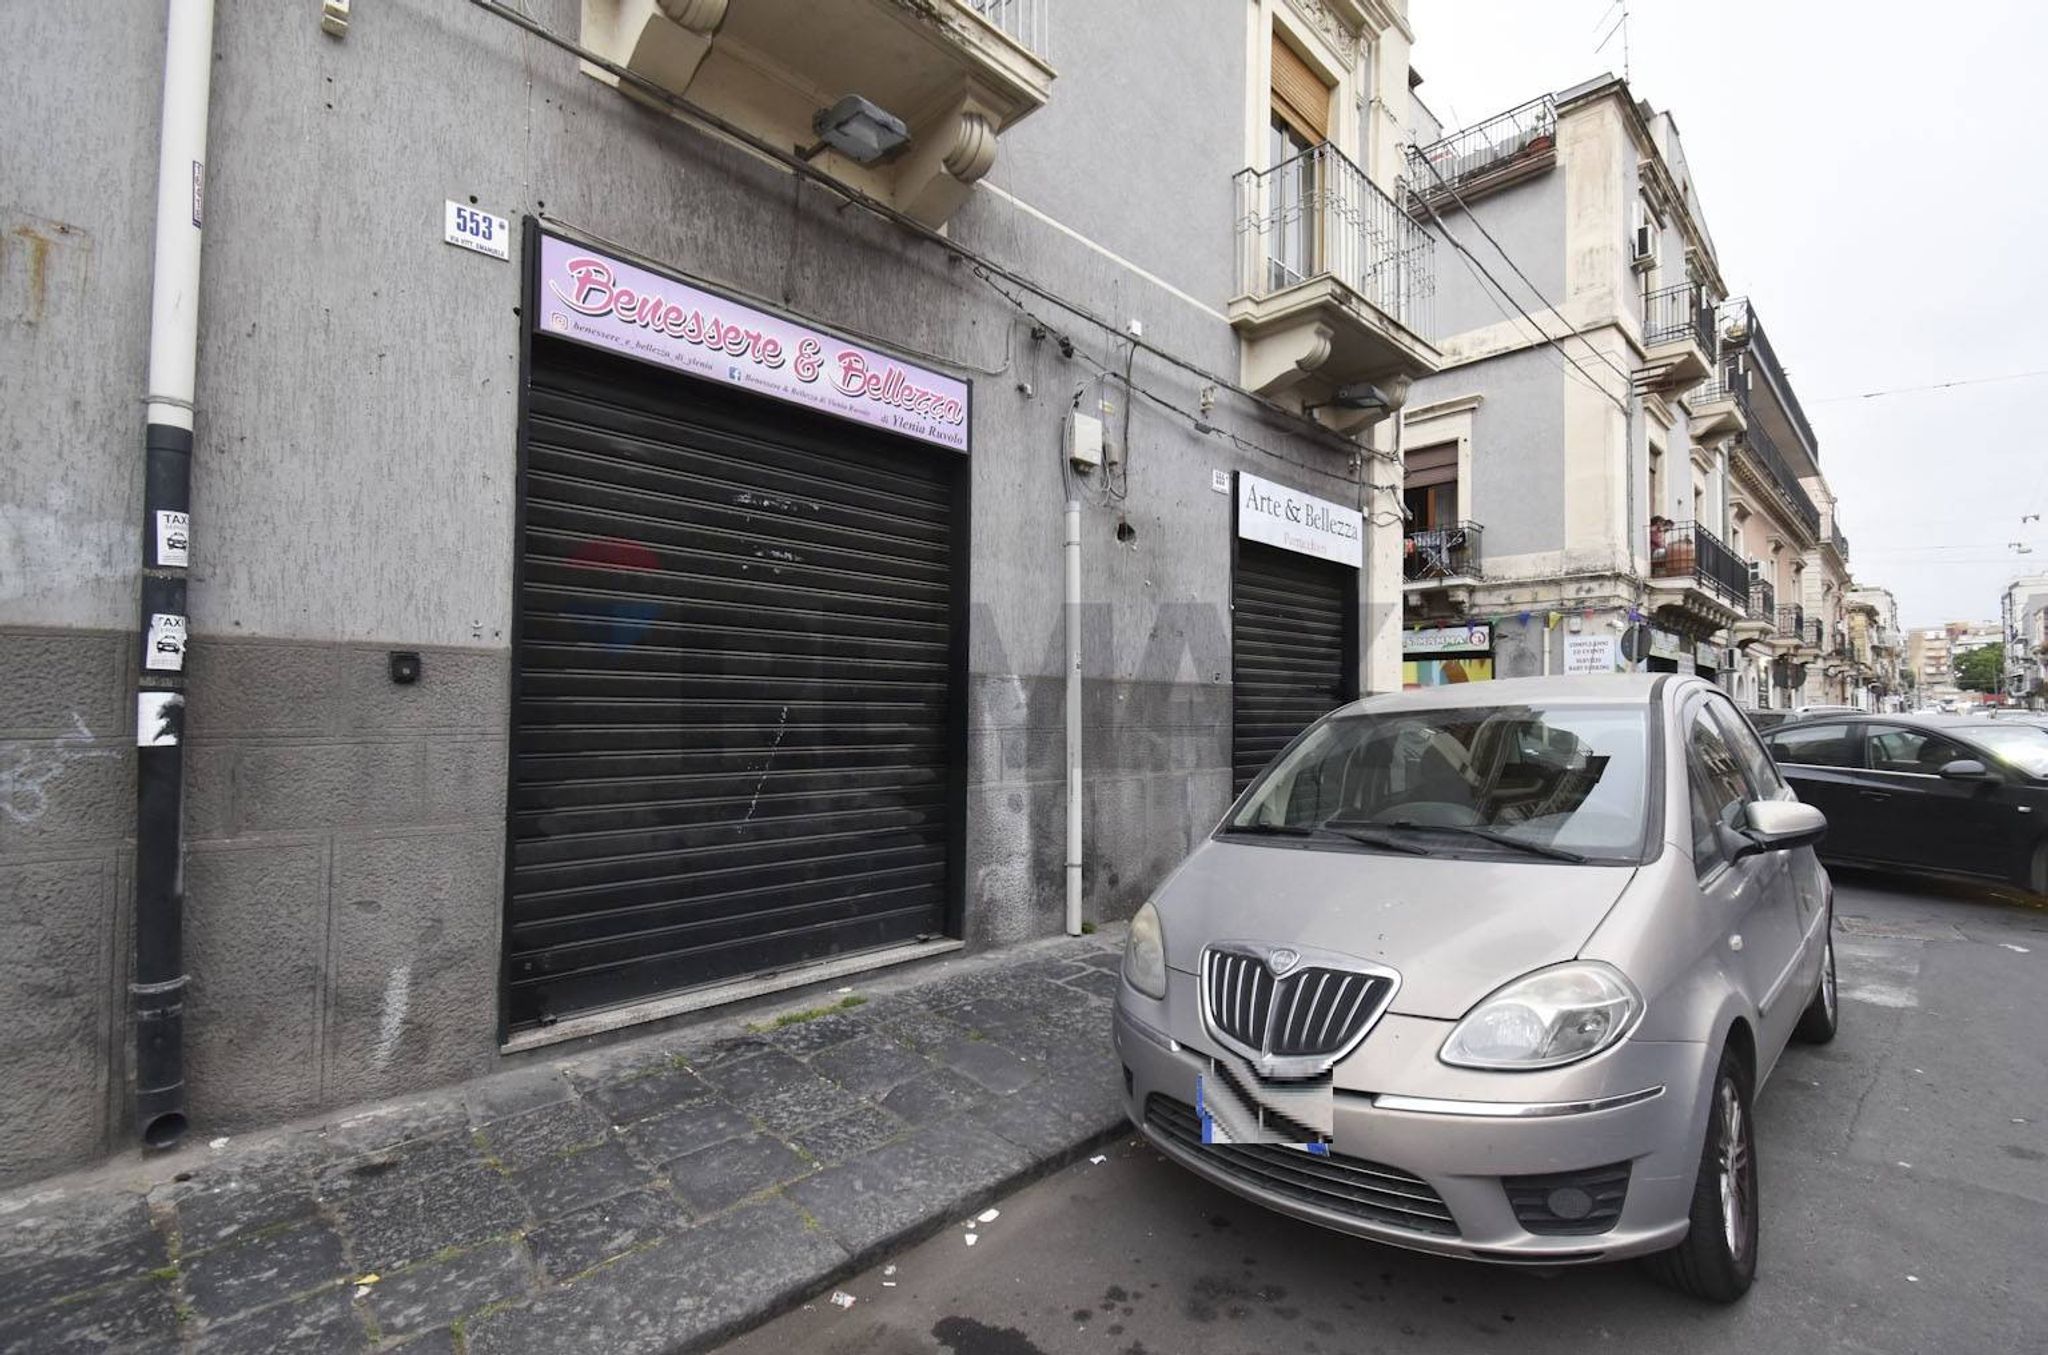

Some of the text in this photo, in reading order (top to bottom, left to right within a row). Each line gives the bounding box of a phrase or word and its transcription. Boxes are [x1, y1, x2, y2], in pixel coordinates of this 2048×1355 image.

[456, 206, 493, 241] 553
[551, 256, 964, 427] Benessere & Bellezza
[881, 414, 963, 445] di Ylenia Ruvolo
[1246, 483, 1358, 541] Arte & Bellezza
